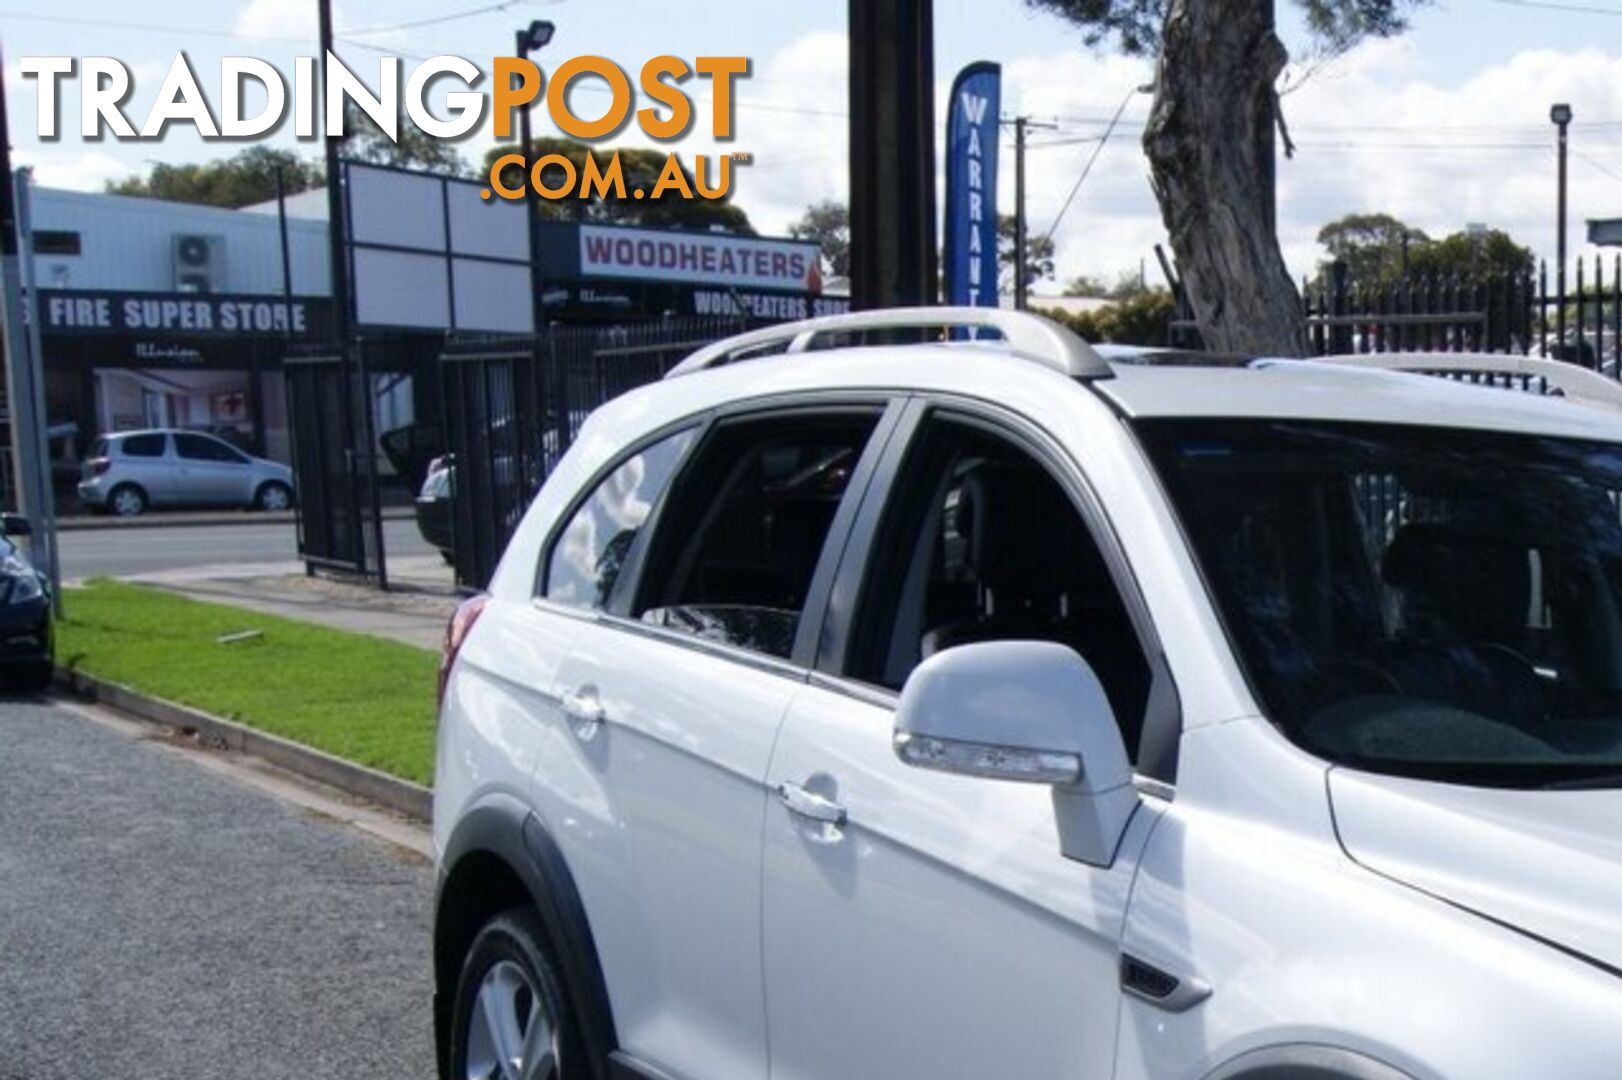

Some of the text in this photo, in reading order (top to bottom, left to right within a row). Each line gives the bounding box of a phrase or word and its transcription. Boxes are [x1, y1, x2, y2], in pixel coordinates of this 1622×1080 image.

[585, 234, 805, 279] WOODHEATERS
[50, 298, 111, 326] FIRE
[124, 299, 213, 328] SUPER
[220, 302, 306, 332] STORE
